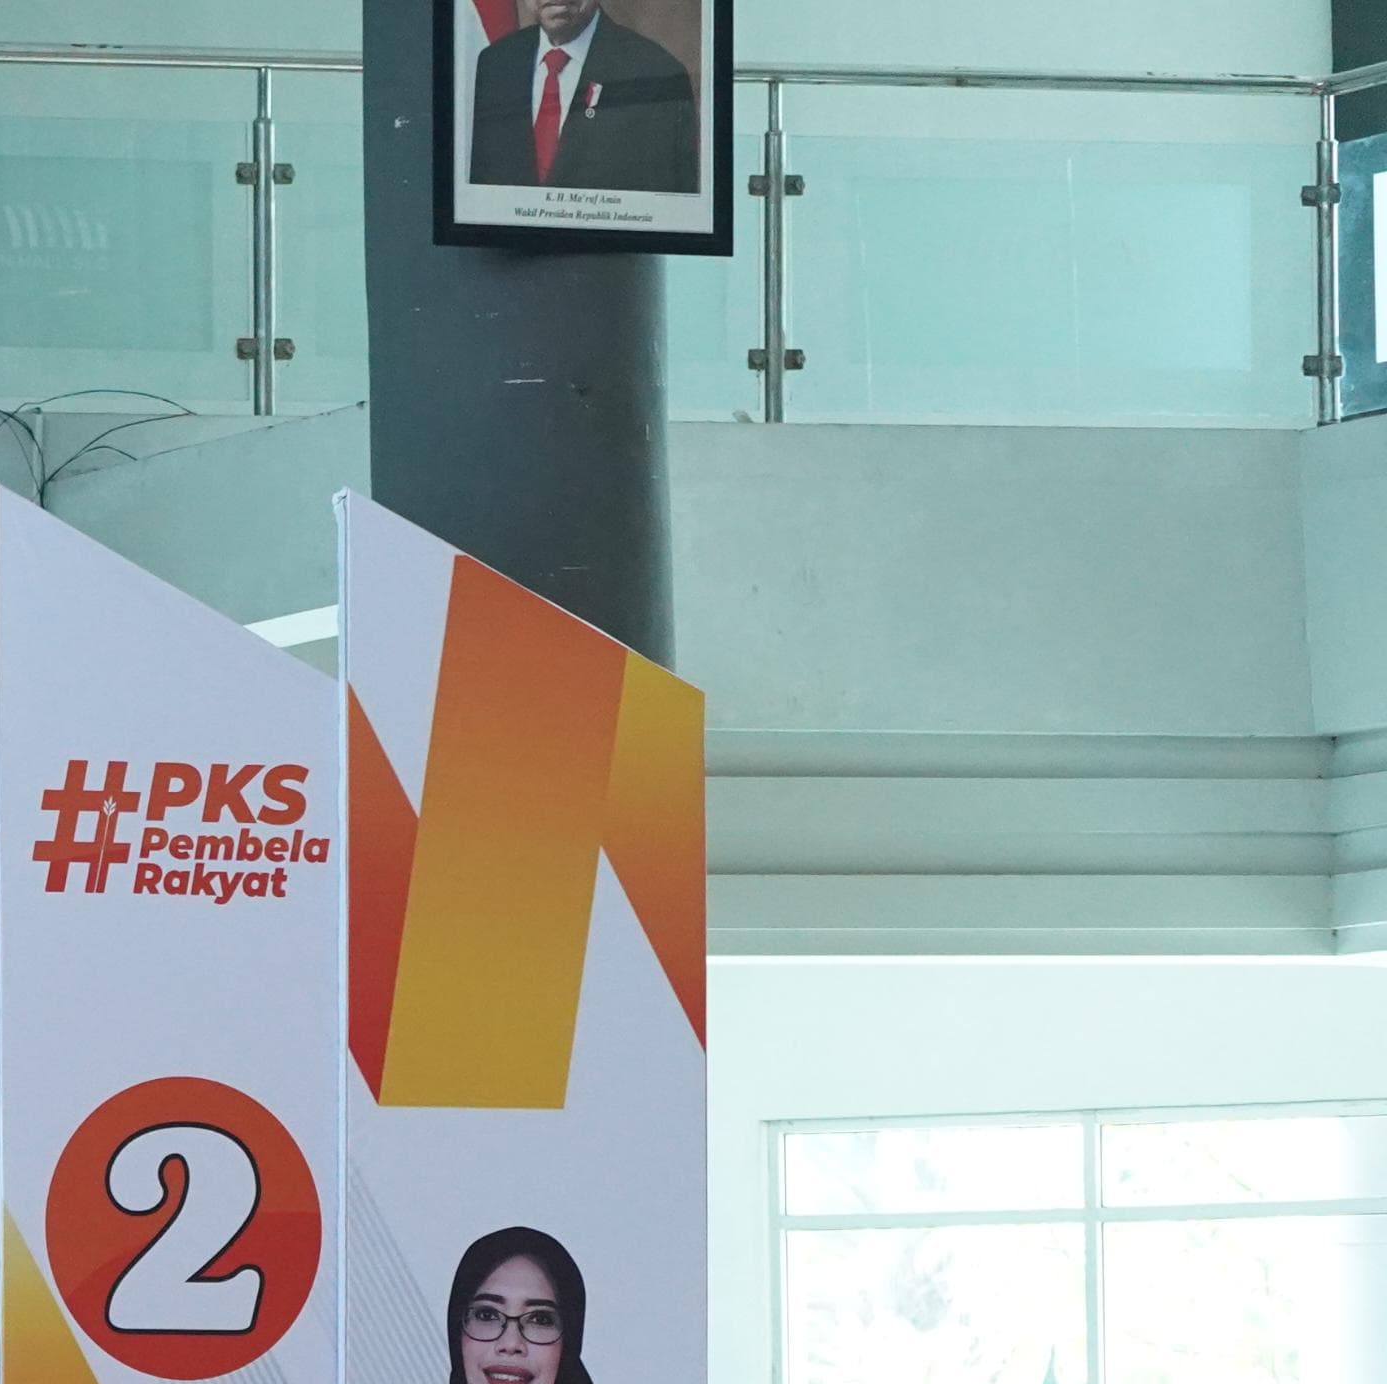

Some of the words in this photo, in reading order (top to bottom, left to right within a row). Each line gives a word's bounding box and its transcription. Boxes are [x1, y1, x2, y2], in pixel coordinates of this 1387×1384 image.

[514, 207, 538, 218] Wakil
[539, 208, 574, 220] Presiden
[575, 209, 612, 222] Republik
[612, 211, 654, 223] Indonesia
[139, 827, 330, 863] Pembela
[133, 862, 287, 905] Rakyat
[103, 1120, 267, 1337] 2
